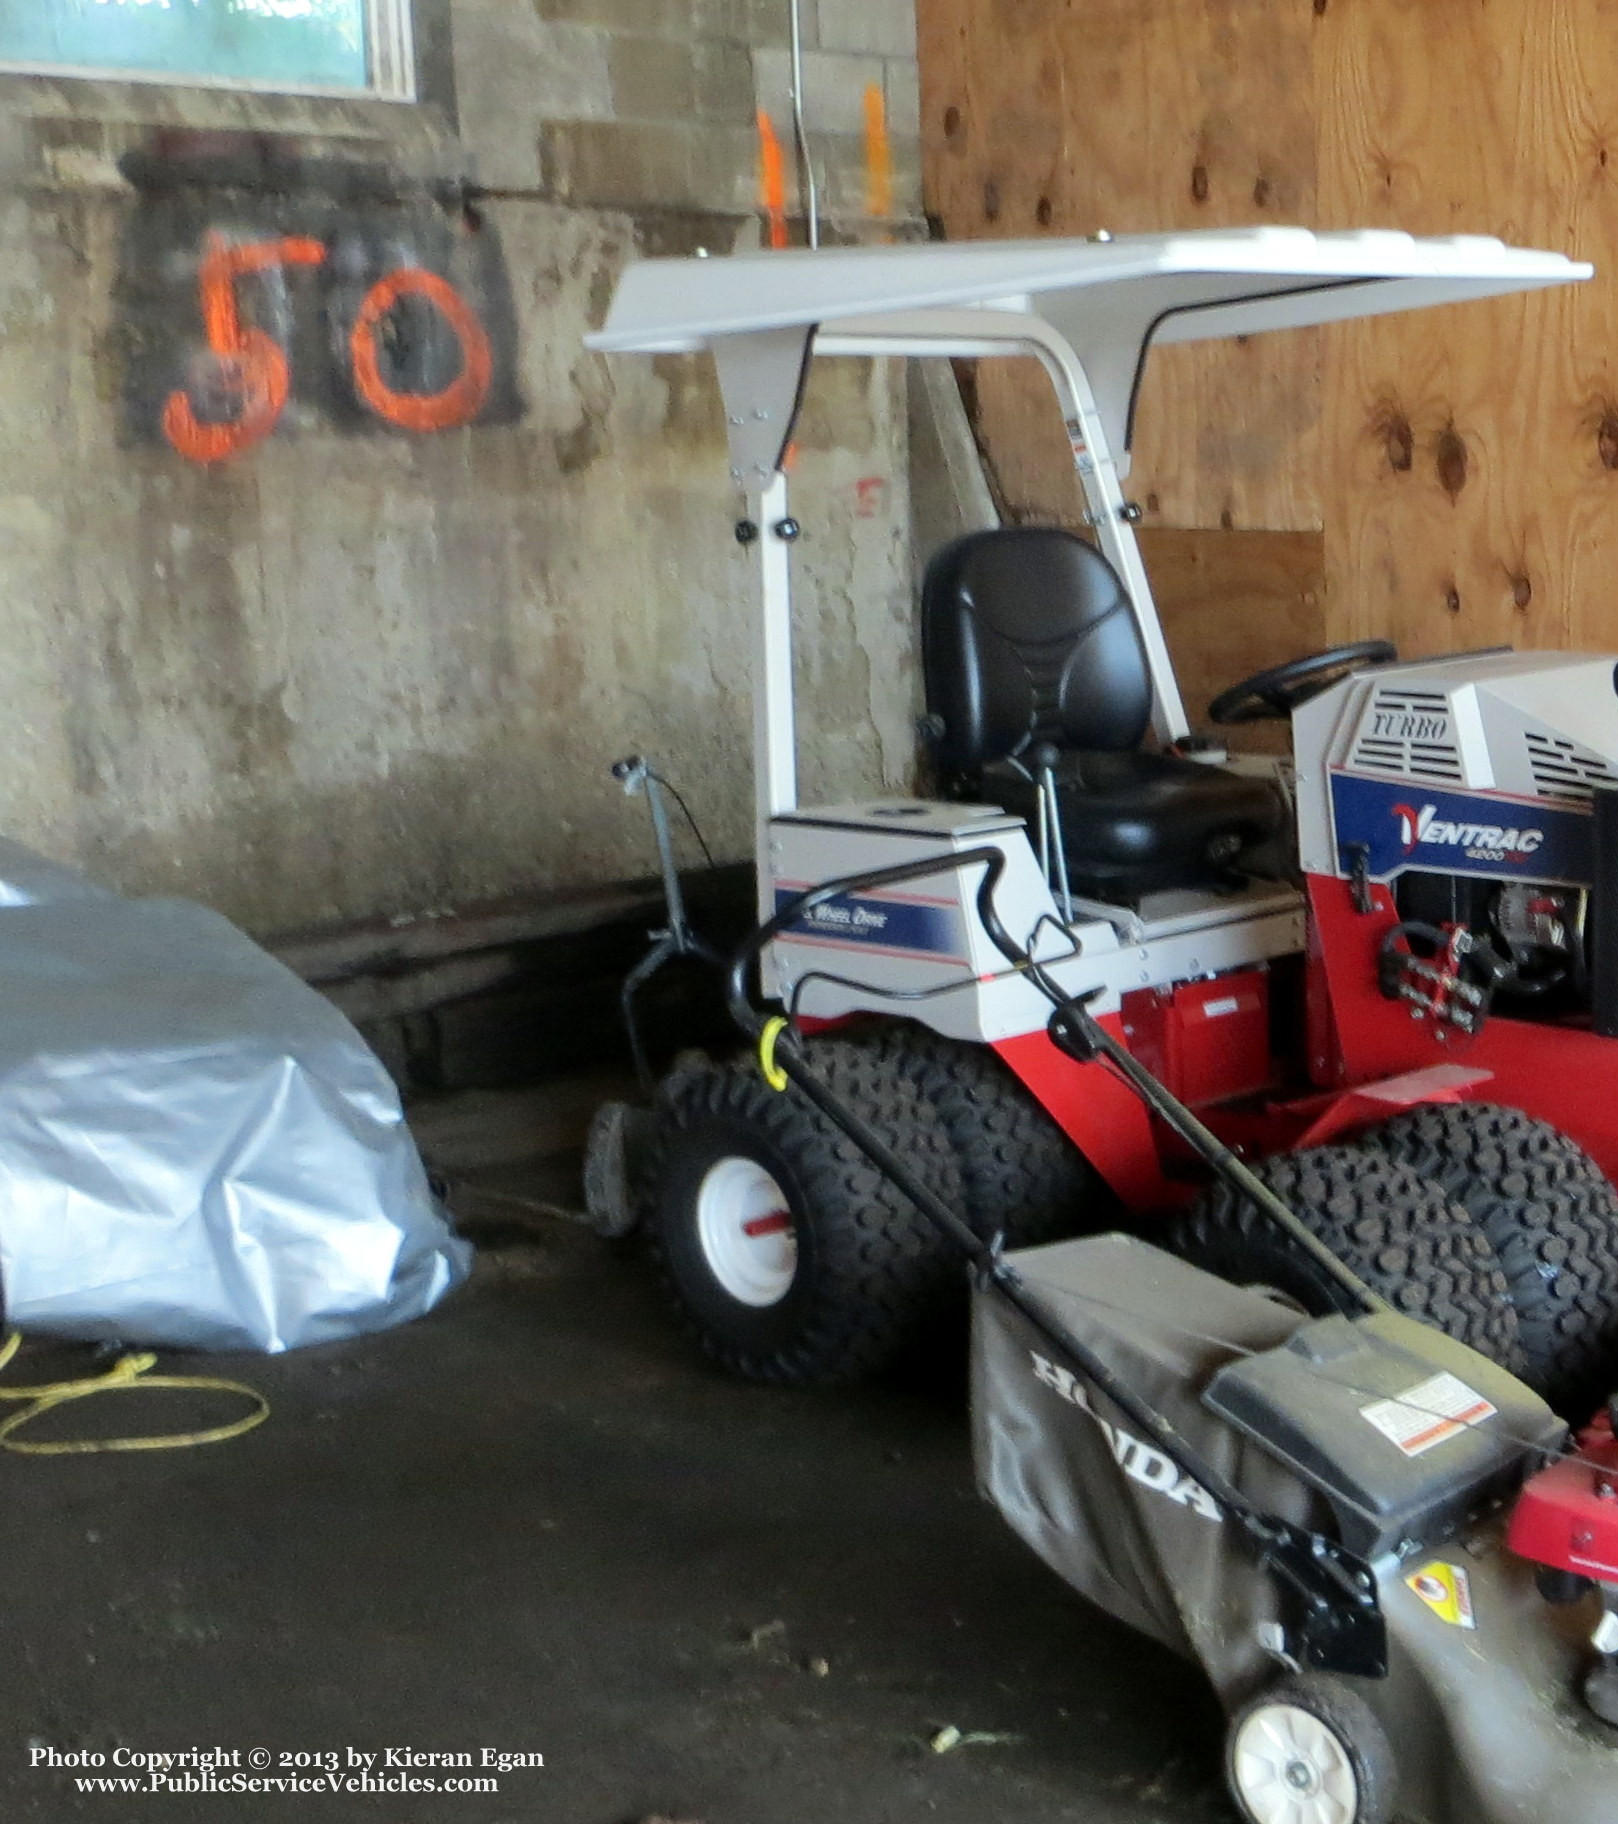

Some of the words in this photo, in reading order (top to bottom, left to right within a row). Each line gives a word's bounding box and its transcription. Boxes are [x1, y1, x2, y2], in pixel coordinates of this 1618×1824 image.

[162, 230, 493, 464] 50
[1373, 713, 1448, 739] TURBO
[1391, 803, 1544, 862] VENTRAC
